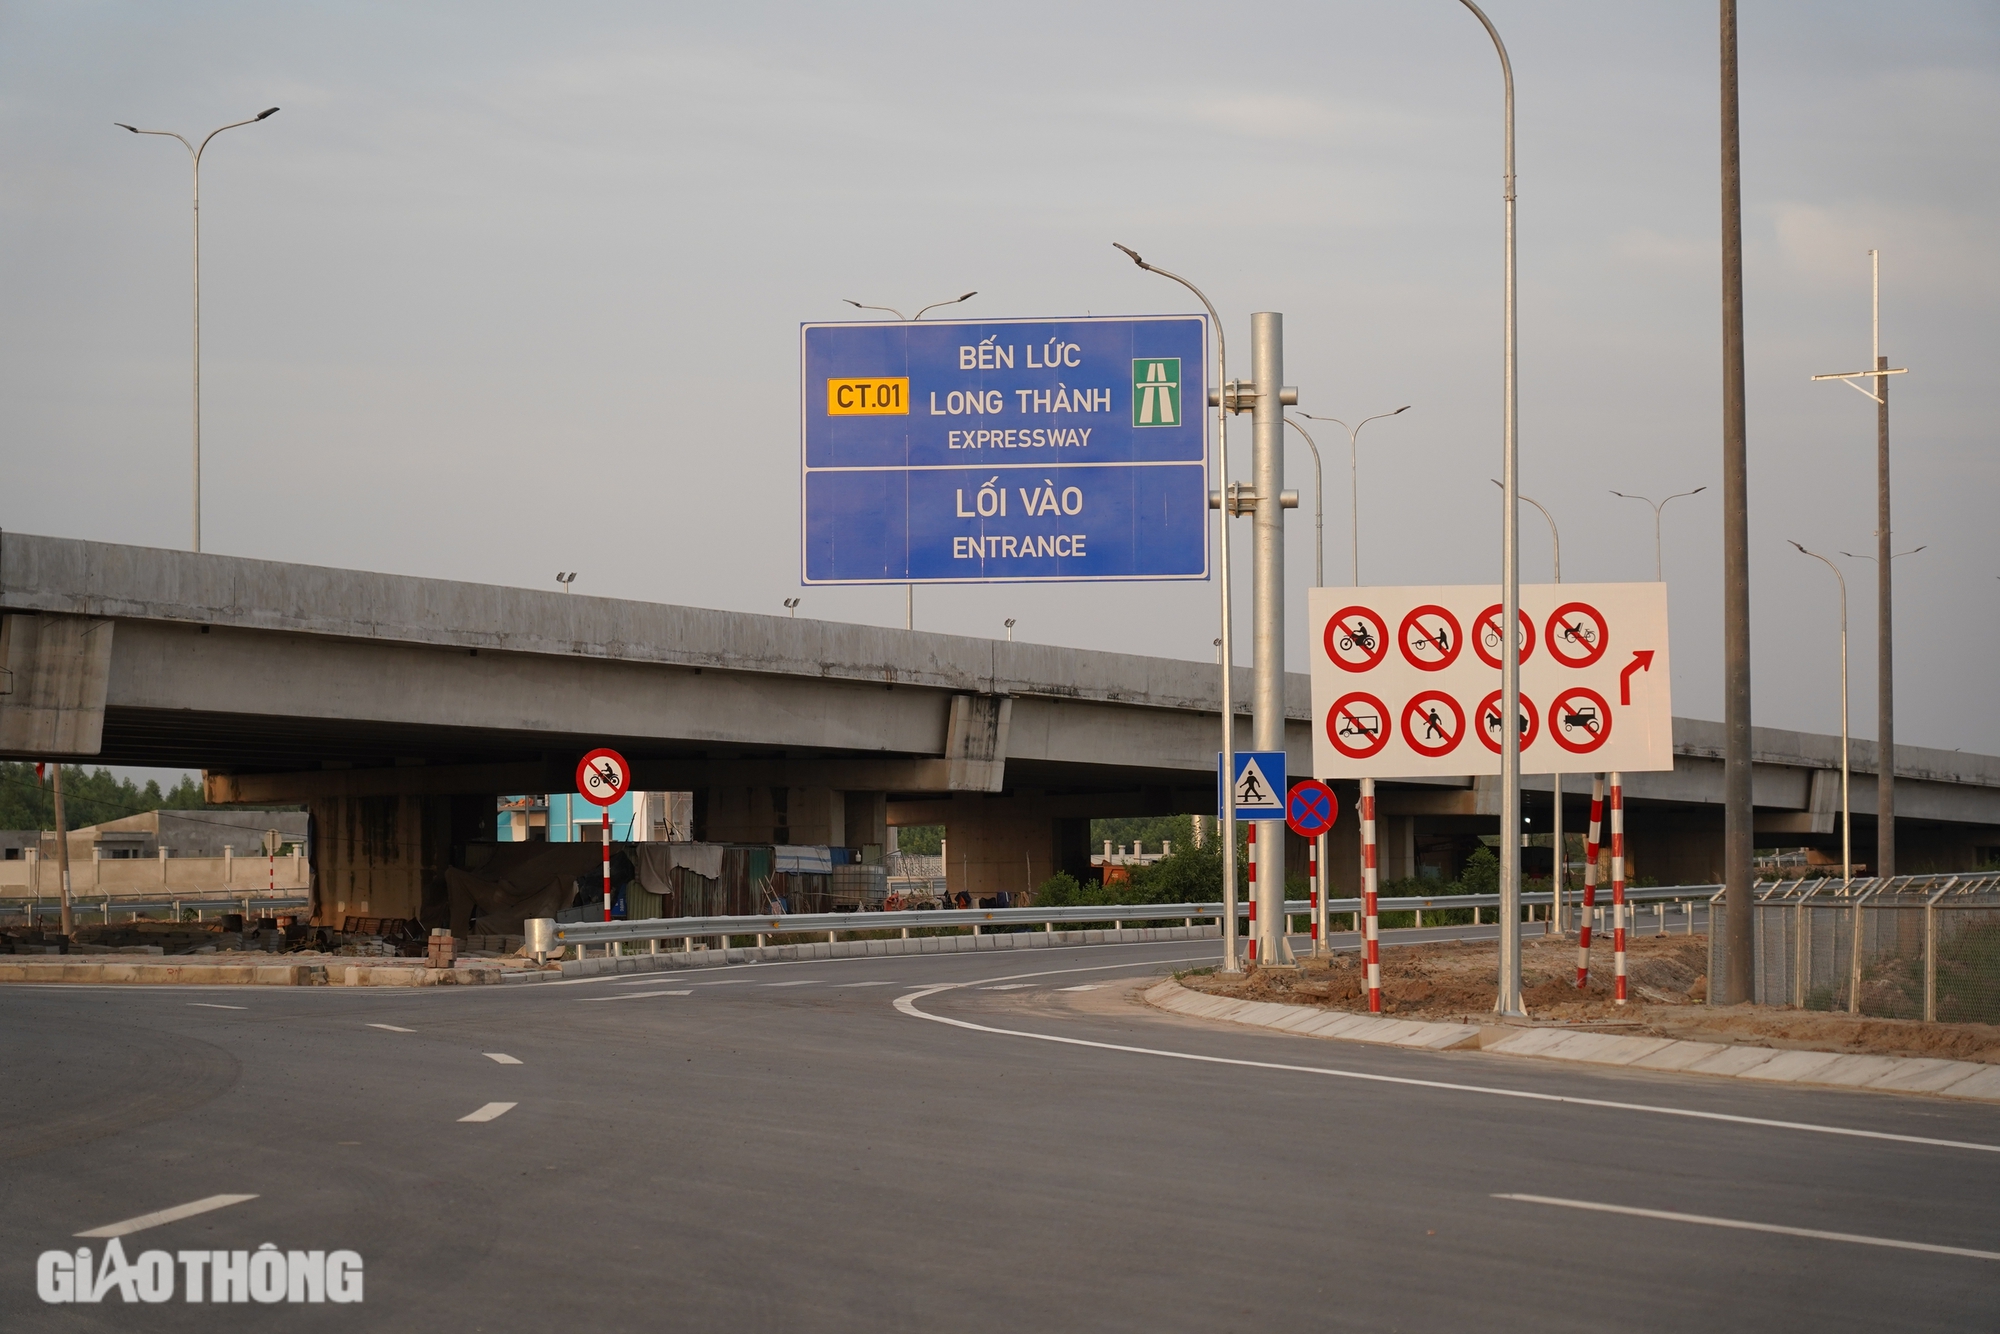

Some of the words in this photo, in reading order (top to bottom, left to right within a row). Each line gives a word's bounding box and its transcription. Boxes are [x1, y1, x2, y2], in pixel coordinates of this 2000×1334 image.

[959, 334, 1014, 370] BẾN
[1027, 336, 1081, 369] LỨC
[837, 383, 900, 408] CT.01
[930, 390, 1003, 416] LONG
[1016, 383, 1111, 413] THÀNH
[948, 428, 1092, 449] EXPRESSWAY
[956, 476, 1006, 517] LỐI
[1019, 479, 1083, 516] VÀO
[953, 534, 1086, 558] ENTRANCE
